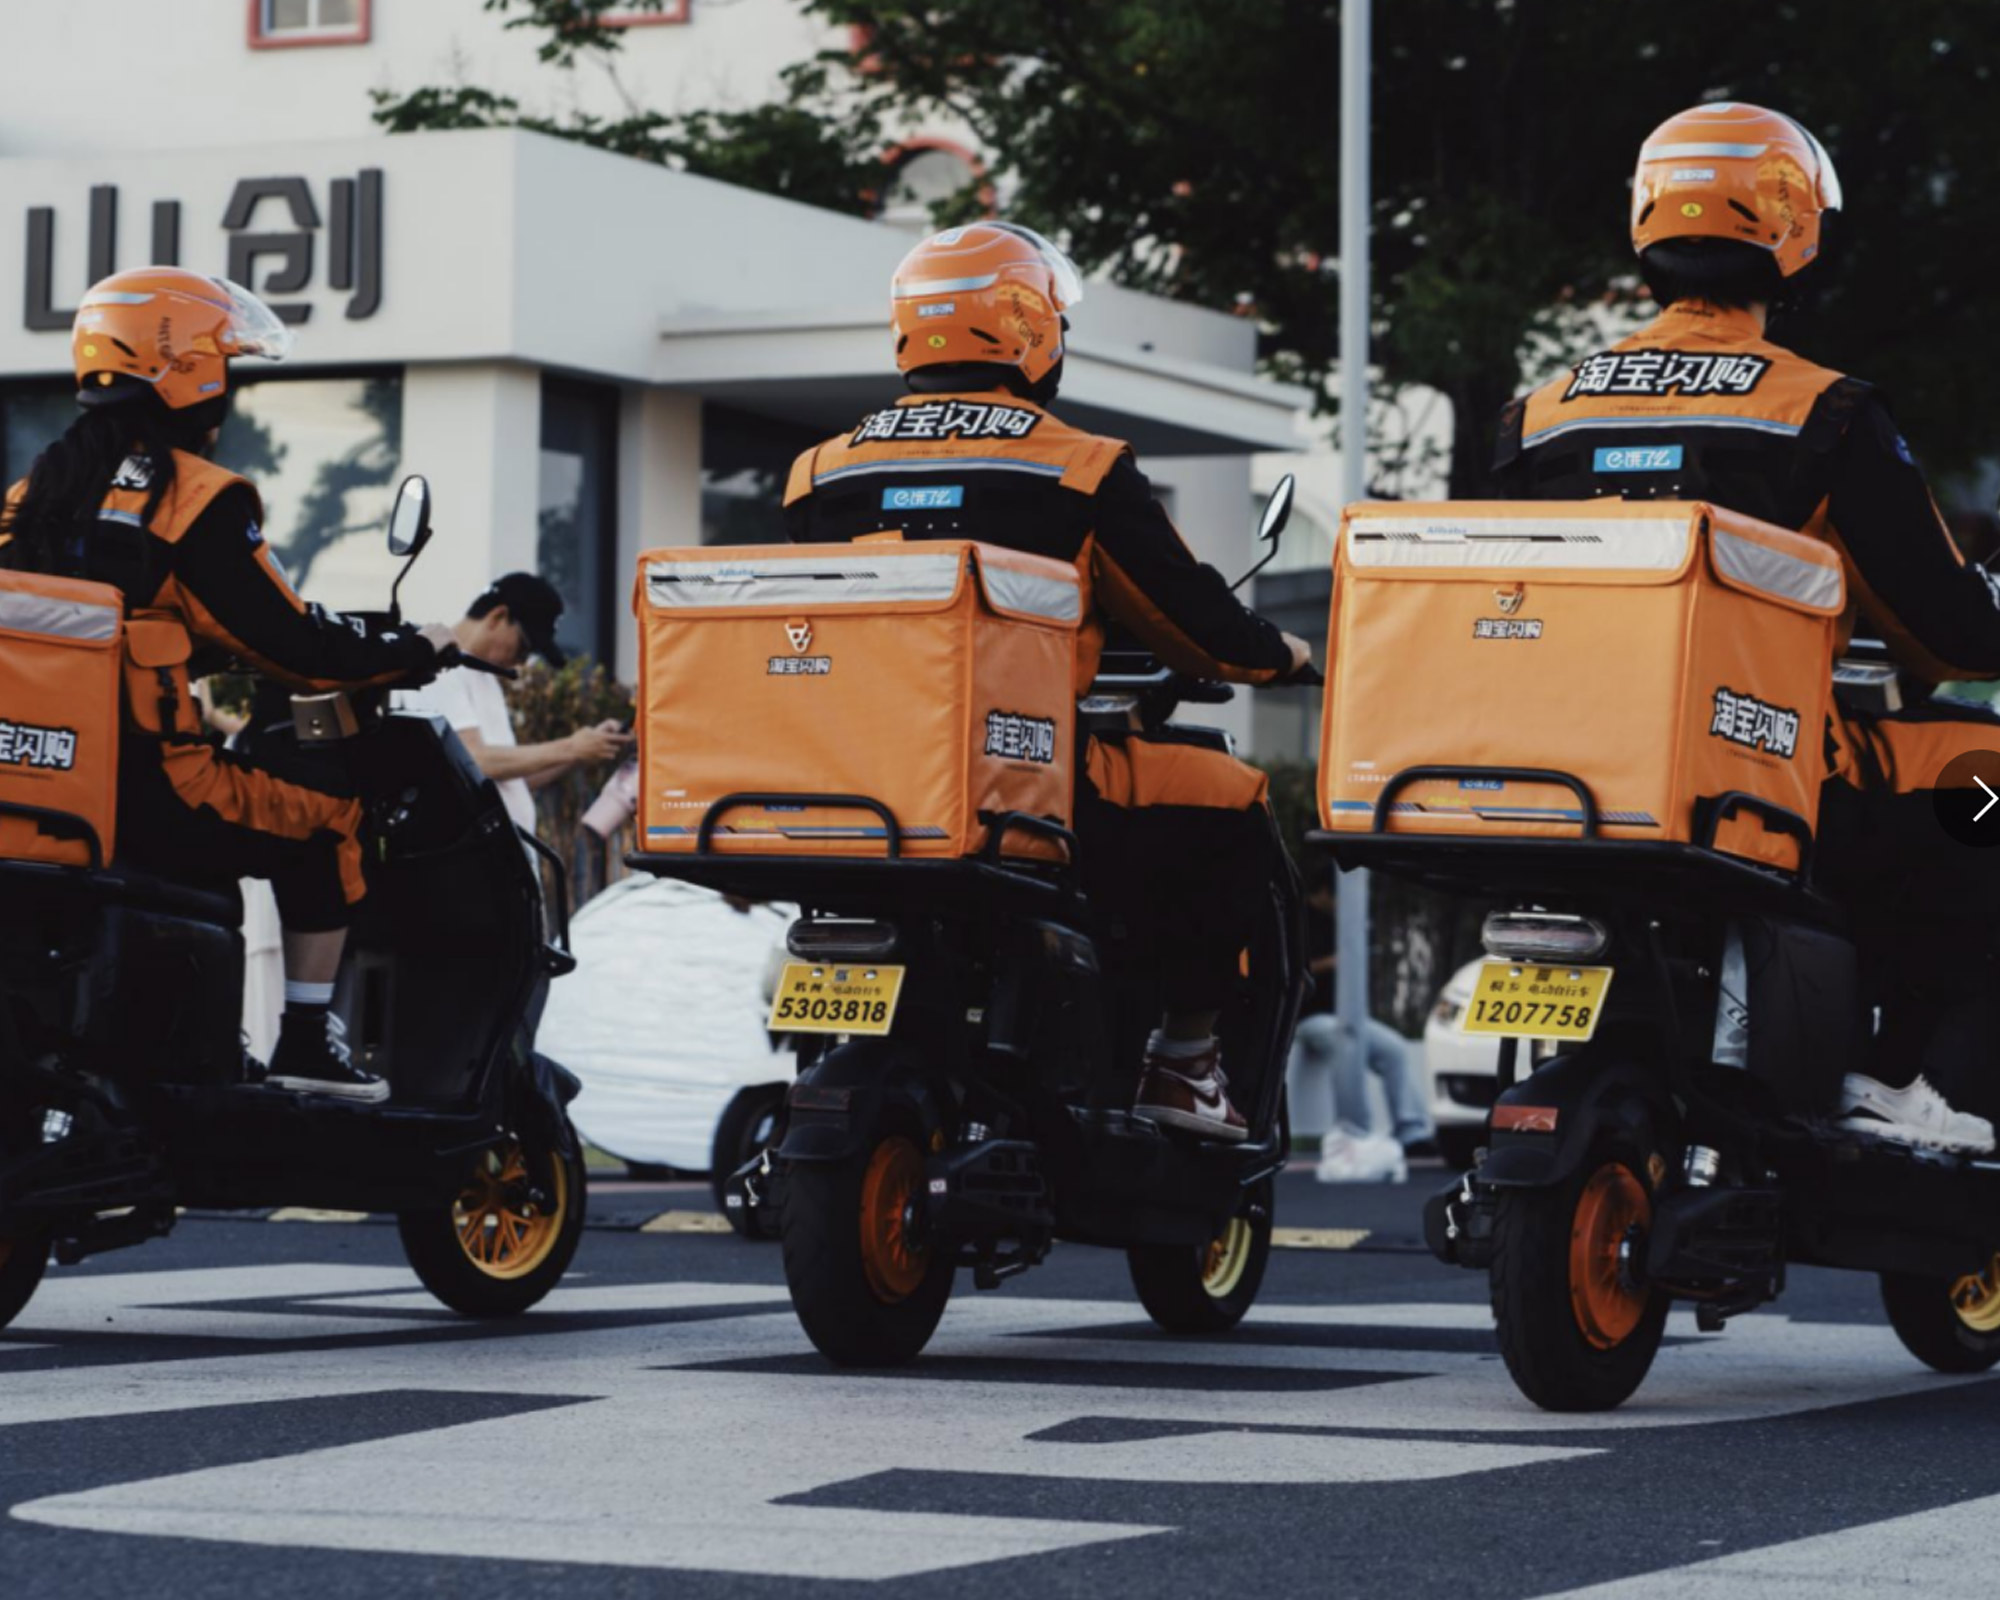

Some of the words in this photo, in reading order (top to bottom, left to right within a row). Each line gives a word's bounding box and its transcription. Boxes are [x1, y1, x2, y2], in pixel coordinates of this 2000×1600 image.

[1567, 352, 1767, 397] 淘宝闪购
[853, 402, 1037, 442] 淘宝闪购
[1474, 619, 1543, 638] 淘宝闪购
[986, 712, 1054, 760] 淘宝闪购
[1711, 690, 1799, 756] 淘宝闪购
[777, 997, 888, 1023] 5303818
[1475, 1000, 1592, 1029] 1207758
